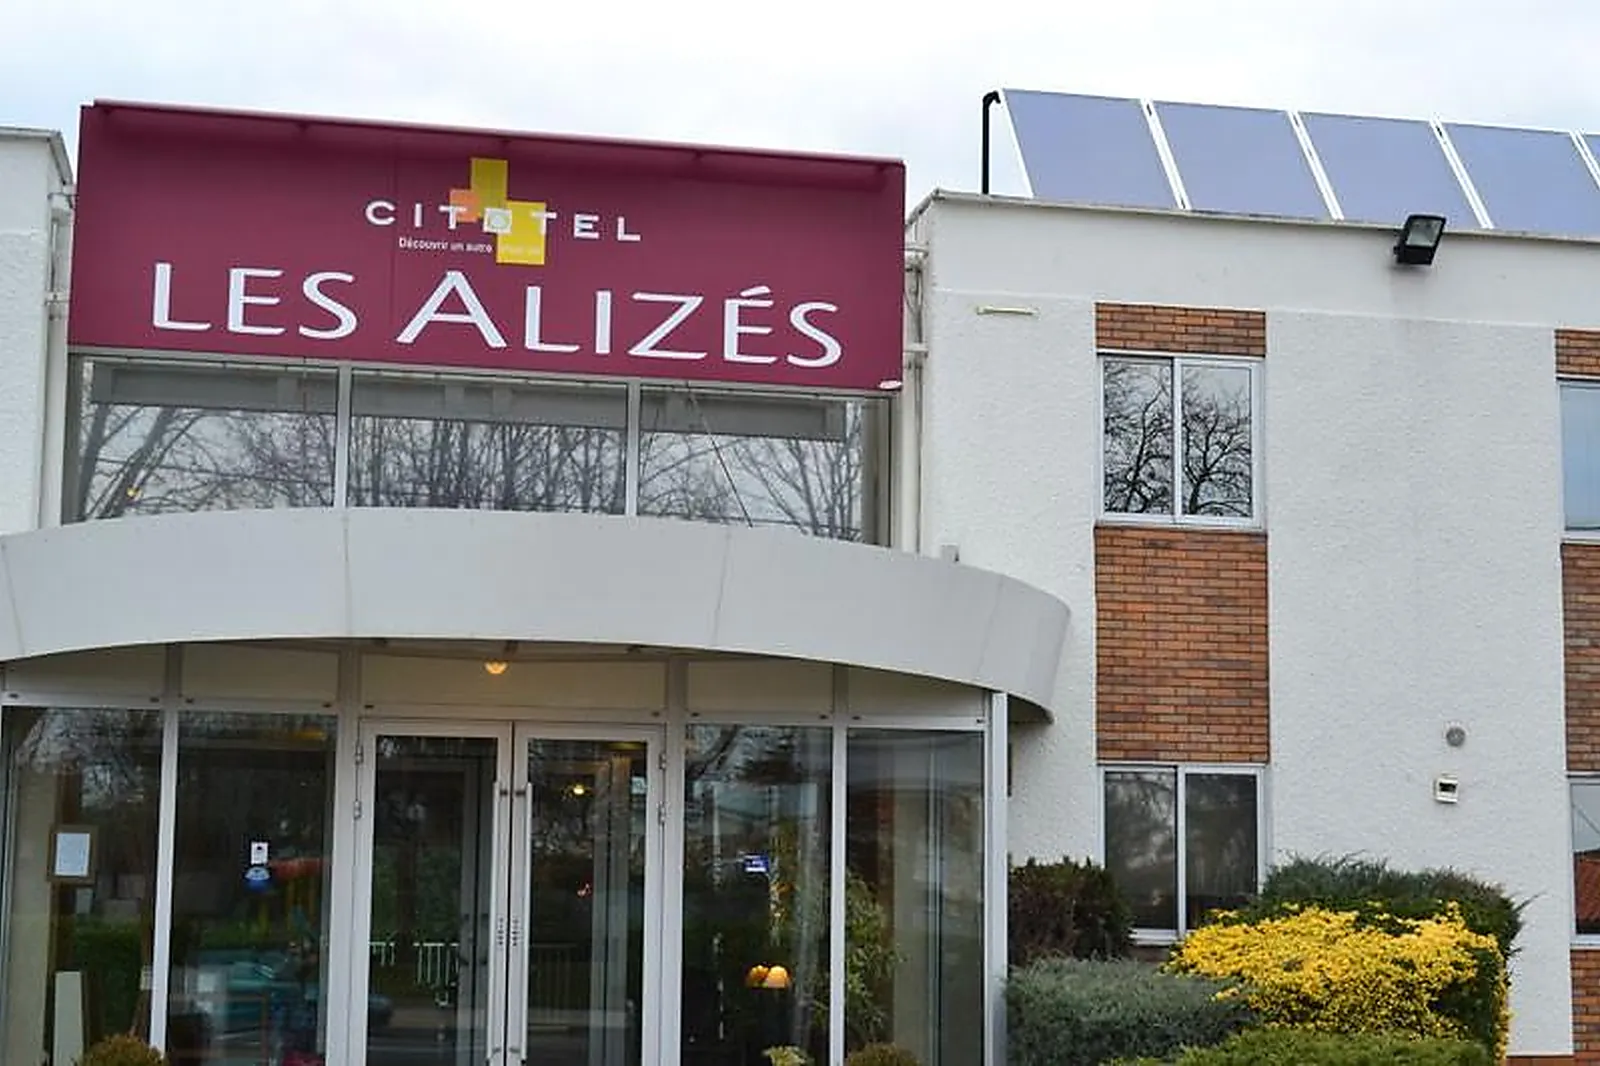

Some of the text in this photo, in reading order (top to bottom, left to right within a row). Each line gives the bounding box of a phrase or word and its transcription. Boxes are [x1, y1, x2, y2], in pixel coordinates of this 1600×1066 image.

[399, 236, 449, 250] Découvrir
[152, 262, 842, 368] LES ALIZÉS
